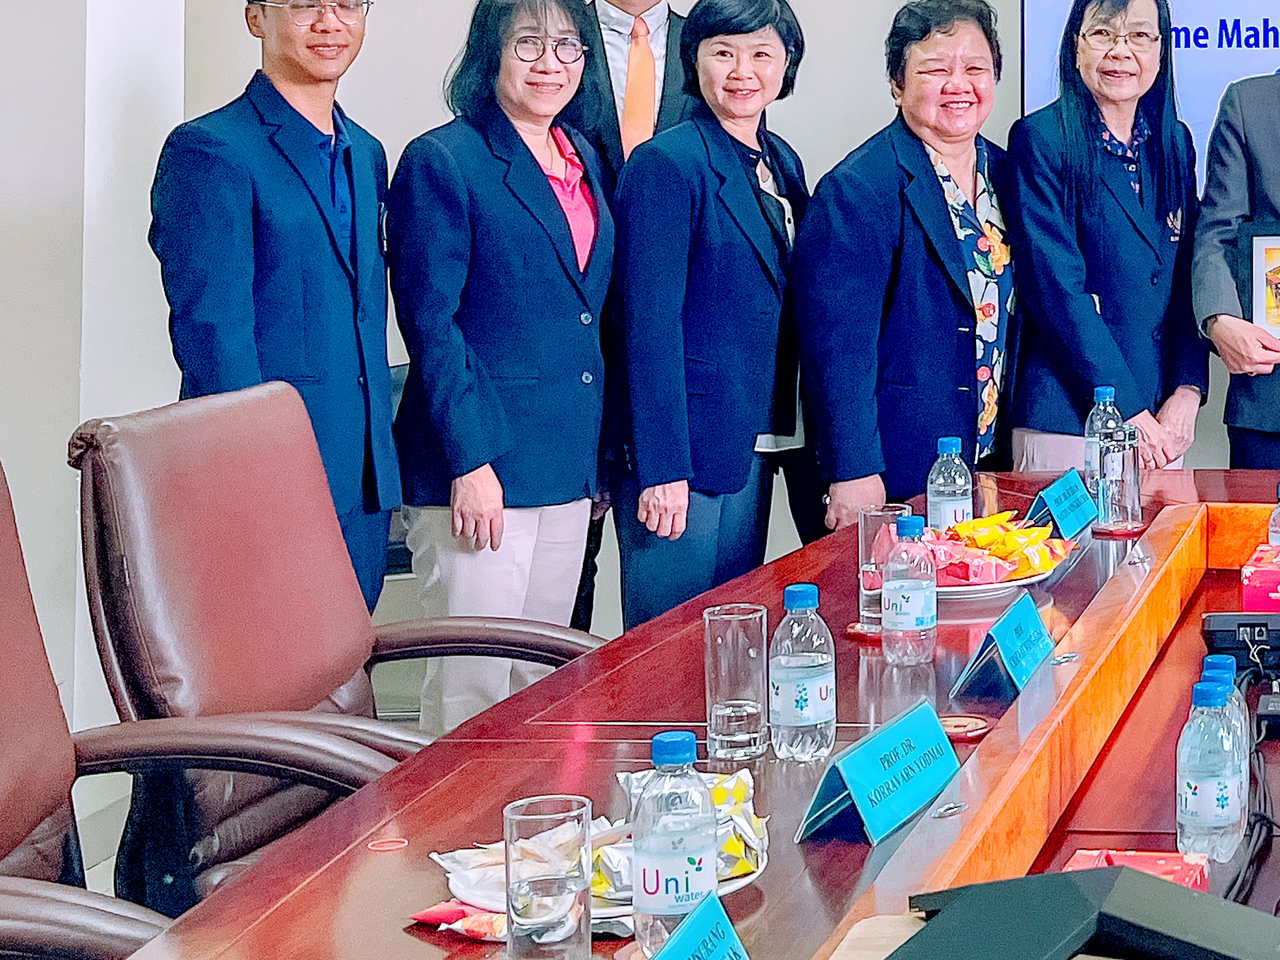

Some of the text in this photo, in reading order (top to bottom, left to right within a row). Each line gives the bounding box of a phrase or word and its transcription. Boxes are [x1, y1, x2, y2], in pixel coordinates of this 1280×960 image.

[884, 597, 902, 610] Uni
[643, 868, 689, 895] Uni
[674, 891, 704, 902] water
